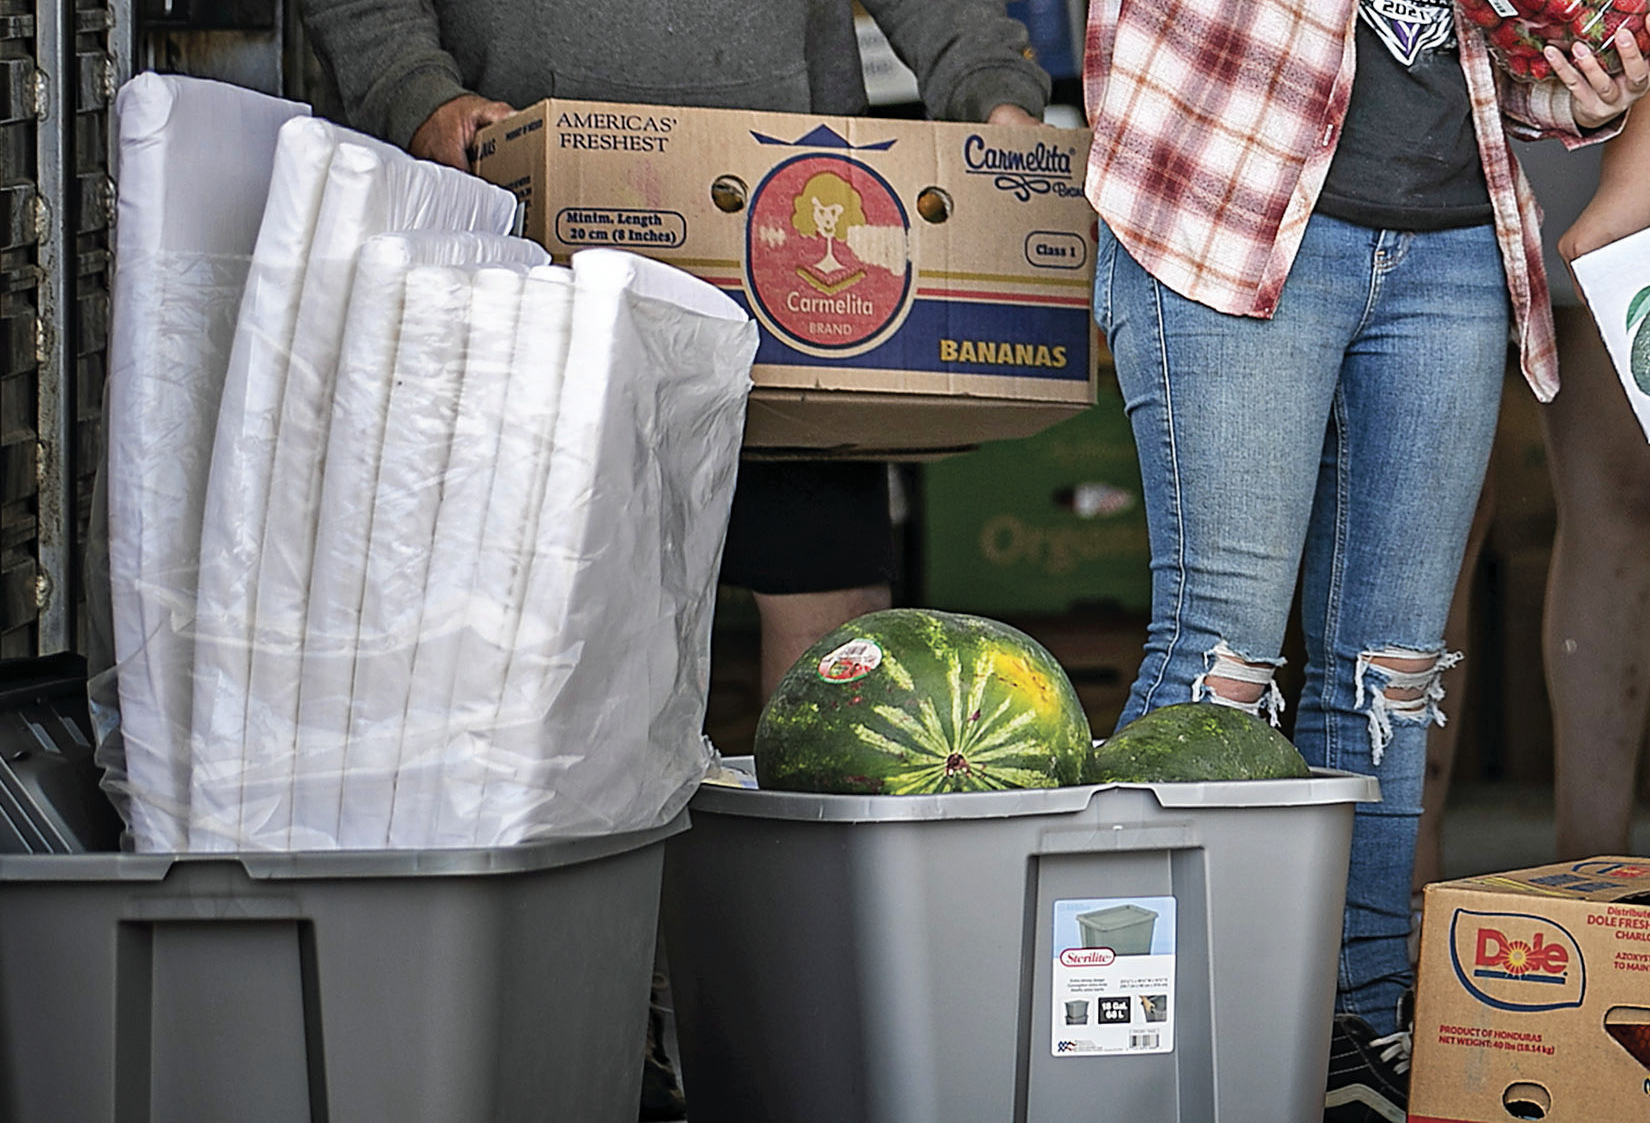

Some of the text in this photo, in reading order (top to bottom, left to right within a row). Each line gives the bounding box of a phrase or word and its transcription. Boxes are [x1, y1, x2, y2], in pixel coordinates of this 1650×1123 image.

[556, 112, 678, 133] AMERICAS'
[559, 132, 669, 153] FRESHEST
[964, 134, 1072, 174] Carmelita
[566, 211, 662, 228] Minim. Length
[570, 228, 585, 241] 20
[588, 231, 609, 241] cm
[612, 228, 625, 243] (8
[1035, 244, 1066, 257] Class
[786, 291, 874, 316] Carmelita
[808, 322, 852, 336] BRAND
[940, 339, 1068, 368] BANANAS
[1587, 914, 1616, 927] DOLE
[1066, 951, 1107, 963] Sterilite
[1475, 928, 1569, 975] Dole
[1614, 961, 1626, 969] TO
[1438, 1035, 1456, 1044] NET
[1457, 1037, 1492, 1047] WEIGHT:
[1439, 1024, 1542, 1043] PRODUCT OF HONDURAS
